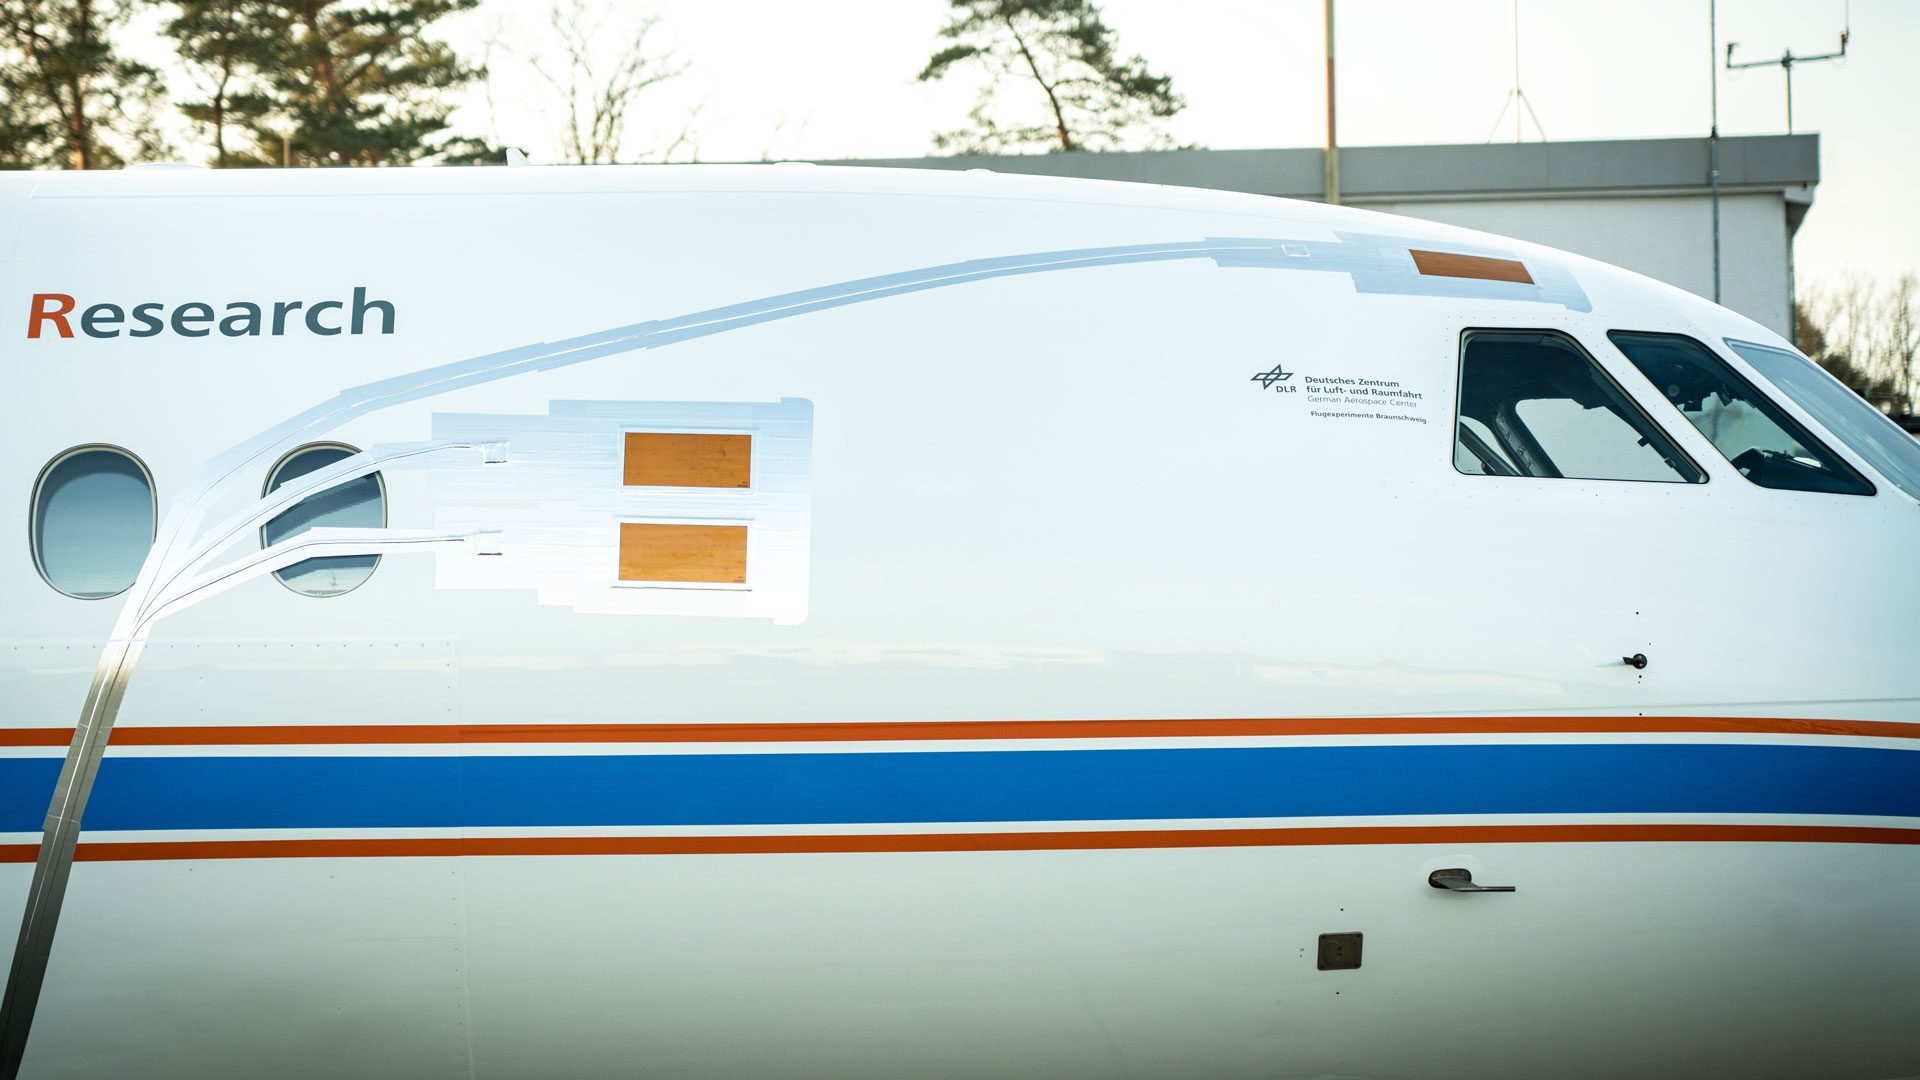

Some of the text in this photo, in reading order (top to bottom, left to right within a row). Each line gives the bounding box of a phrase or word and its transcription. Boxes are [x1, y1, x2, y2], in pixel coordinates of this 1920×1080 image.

[27, 286, 396, 339] Research
[1305, 376, 1399, 387] Deutsches Zentrum
[1372, 389, 1423, 399] Raumfahrt
[1307, 395, 1417, 407] German Aerospace Center
[1311, 411, 1427, 424] Flugexperimente Braunschweig
